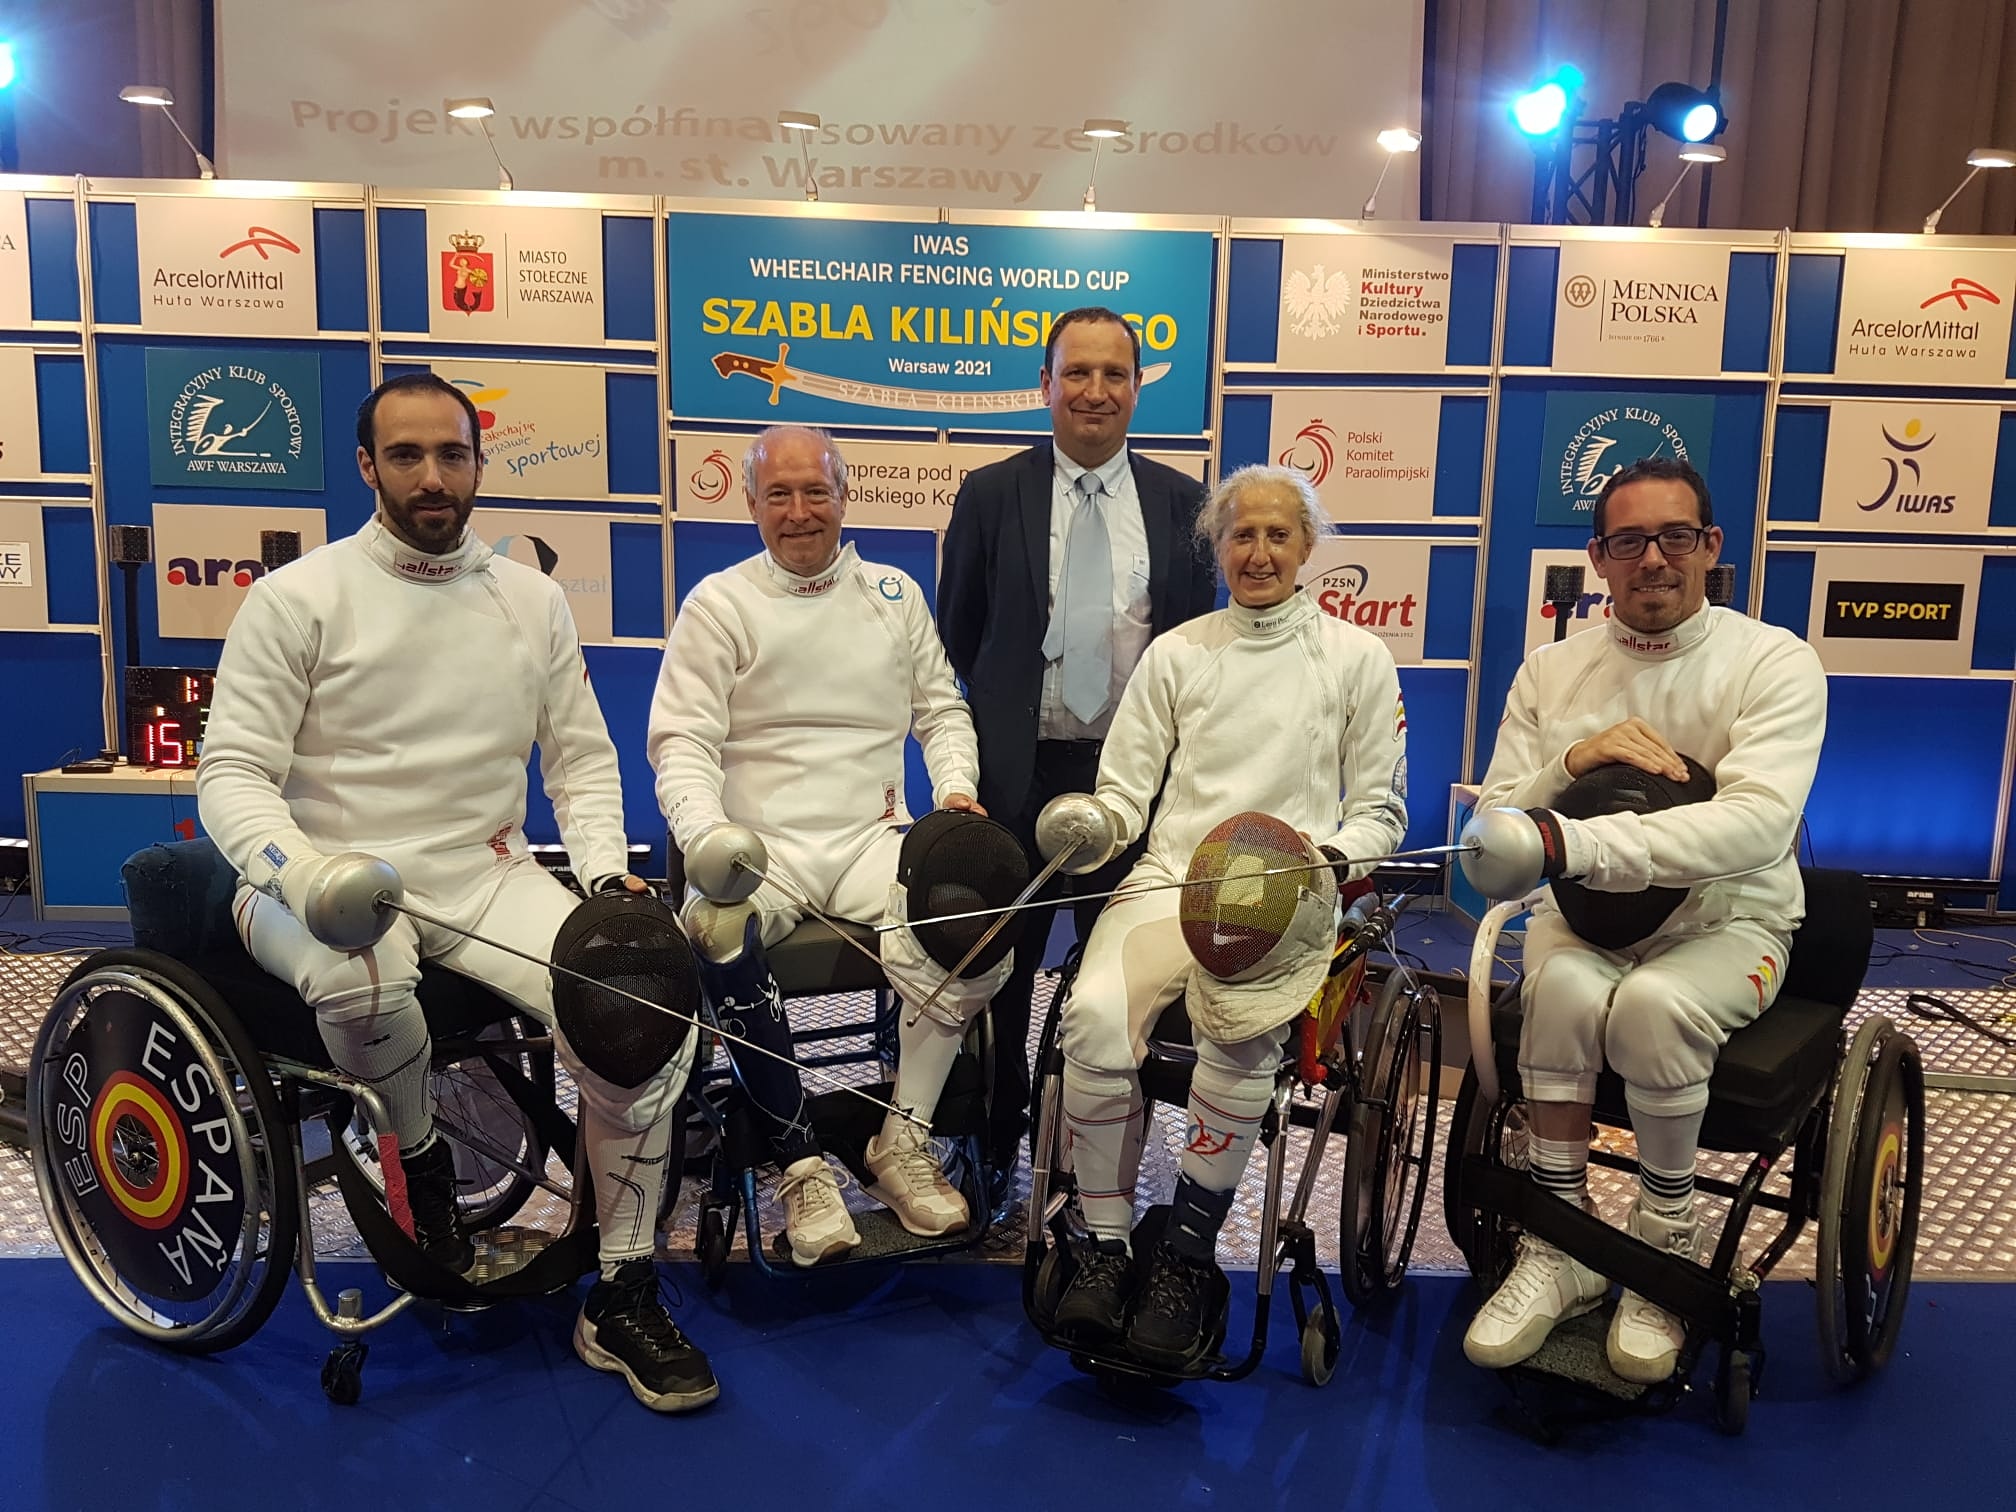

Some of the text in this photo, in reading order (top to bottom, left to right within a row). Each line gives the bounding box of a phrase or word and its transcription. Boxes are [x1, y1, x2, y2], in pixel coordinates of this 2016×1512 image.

[598, 153, 664, 180] m.
[762, 154, 1043, 204] Warszawy
[913, 234, 969, 256] IWAS
[519, 250, 567, 264] MIASTO
[153, 268, 283, 291] ArcelorMittal
[519, 270, 588, 285] STOŁECZNE
[749, 257, 1130, 291] WHEELCHAIR FENCING WORLD CUP
[1362, 268, 1449, 281] Ministerstwo
[520, 289, 593, 304] WARSZAWA
[1361, 282, 1423, 298] Kultury
[1612, 279, 1719, 302] MENNICA
[153, 294, 284, 309] Huta Warszawa
[1360, 298, 1440, 309] Dziedzictwa
[1359, 310, 1443, 323] Narodowego
[1610, 302, 1698, 324] POLSKA
[702, 297, 1178, 351] SZABLA KILIŃSKO
[1358, 326, 1362, 336] i
[1851, 318, 1979, 341] ArcelorMittal
[1849, 343, 1977, 359] Huta Warszawa
[888, 358, 992, 376] Warsaw 2021
[839, 384, 918, 406] SZABLA
[168, 365, 302, 459] INTEGRACYJNY KLUB SPORTOWY
[484, 436, 531, 457] arszawie
[1348, 431, 1382, 443] Polski
[506, 433, 600, 477] sportowej
[1346, 450, 1394, 461] Komitet
[1561, 408, 1618, 495] INTEGRACYJNY
[1624, 407, 1661, 426] KLUB
[187, 459, 287, 474] AWF WARSZAWA
[845, 463, 910, 481] mpreza
[917, 464, 952, 484] pod
[1345, 466, 1430, 480] Paraolimpijski
[847, 485, 926, 509] olskiego
[1896, 494, 1955, 513] IWAS
[167, 557, 266, 588] ara
[1322, 577, 1356, 588] PZSN
[1318, 589, 1417, 627] Start
[1837, 601, 1951, 620] TVP SPORT
[1620, 636, 1670, 651] allstar
[57, 1052, 99, 1197] ESP
[141, 1021, 235, 1286] ESPAÑA
